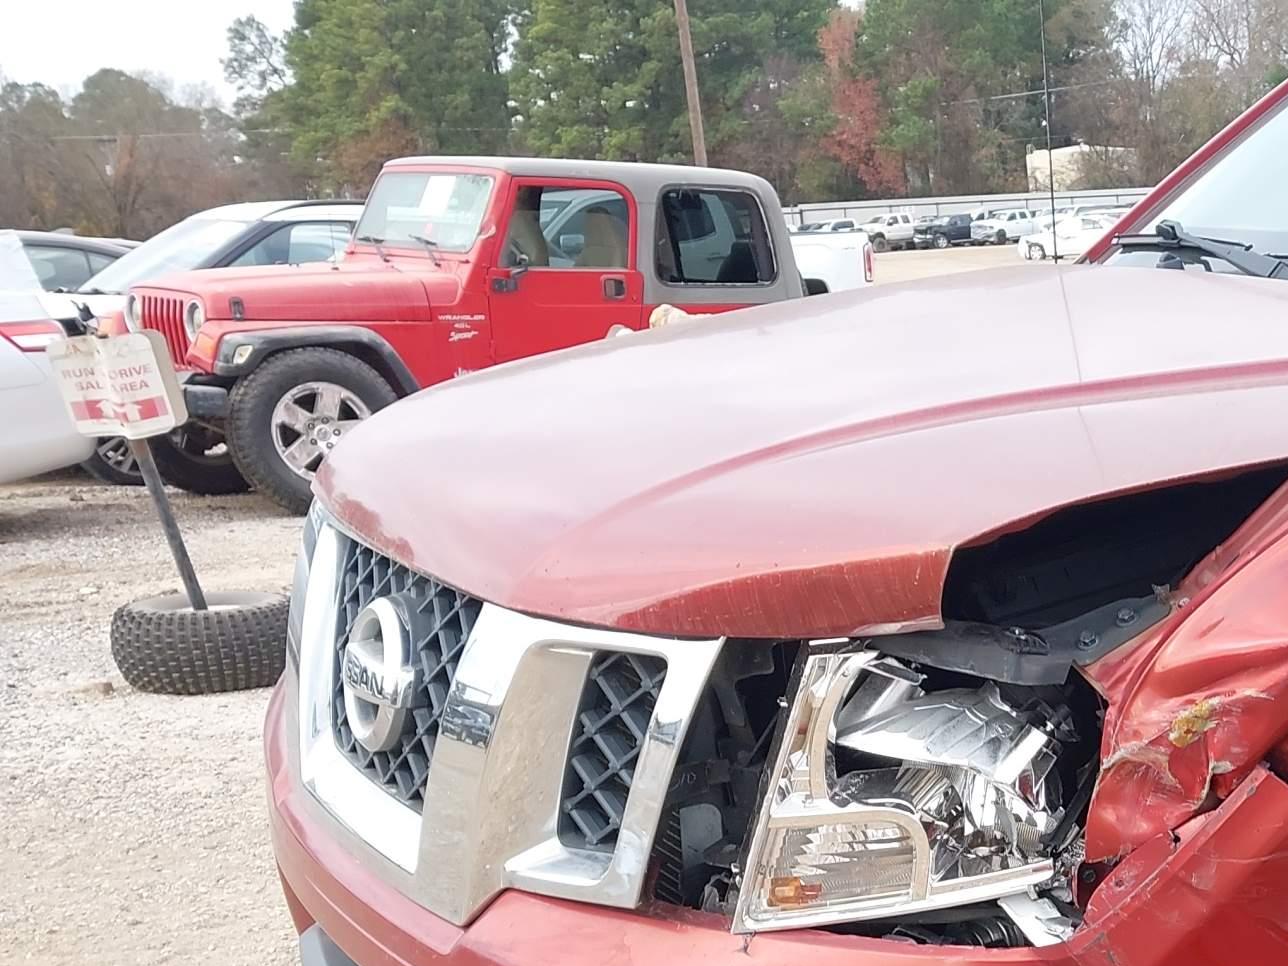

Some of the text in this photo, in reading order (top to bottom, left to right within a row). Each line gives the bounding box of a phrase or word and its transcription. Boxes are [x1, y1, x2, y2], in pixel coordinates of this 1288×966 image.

[61, 367, 96, 380] RUN
[108, 363, 152, 380] DRIVE
[75, 380, 105, 392] SAL
